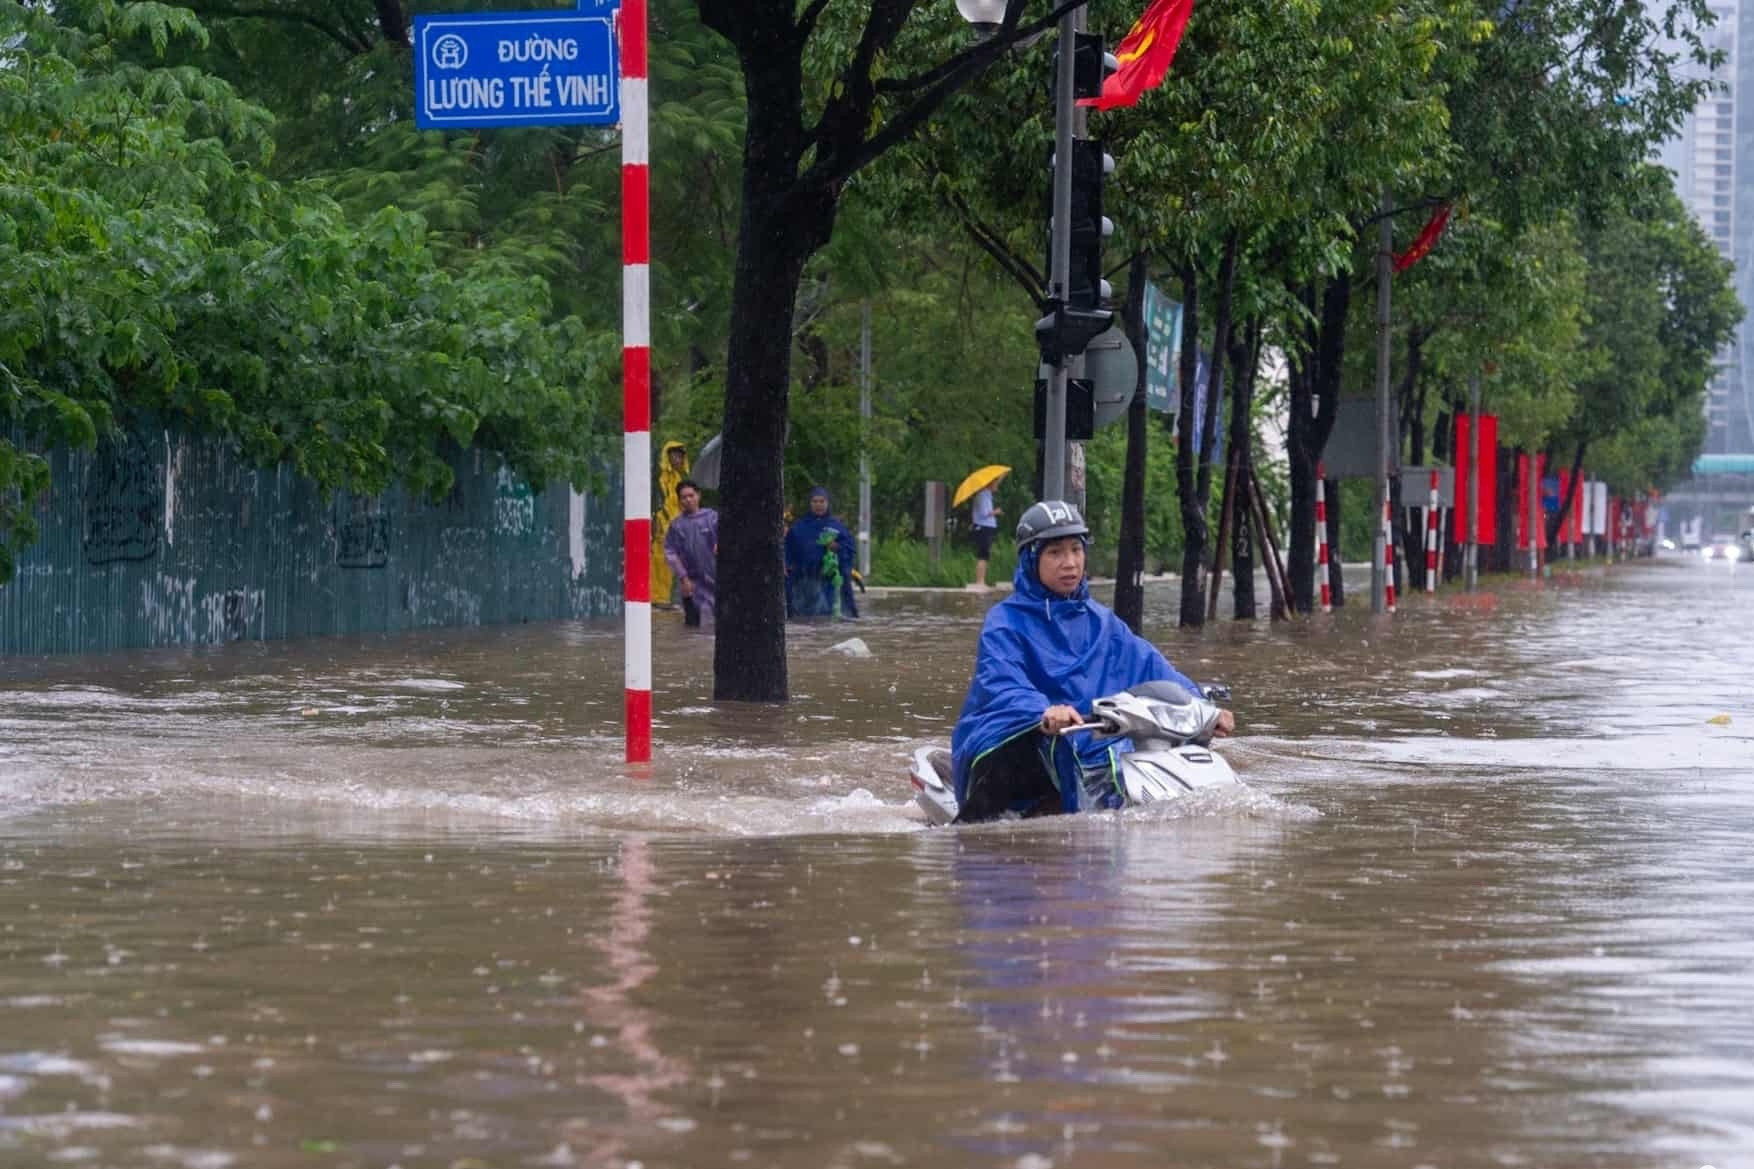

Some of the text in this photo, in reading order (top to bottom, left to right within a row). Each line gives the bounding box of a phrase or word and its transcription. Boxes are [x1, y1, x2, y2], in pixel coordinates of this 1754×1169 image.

[498, 33, 578, 62] ĐƯỜNG
[429, 63, 608, 109] LƯƠNG THẾ VINH
